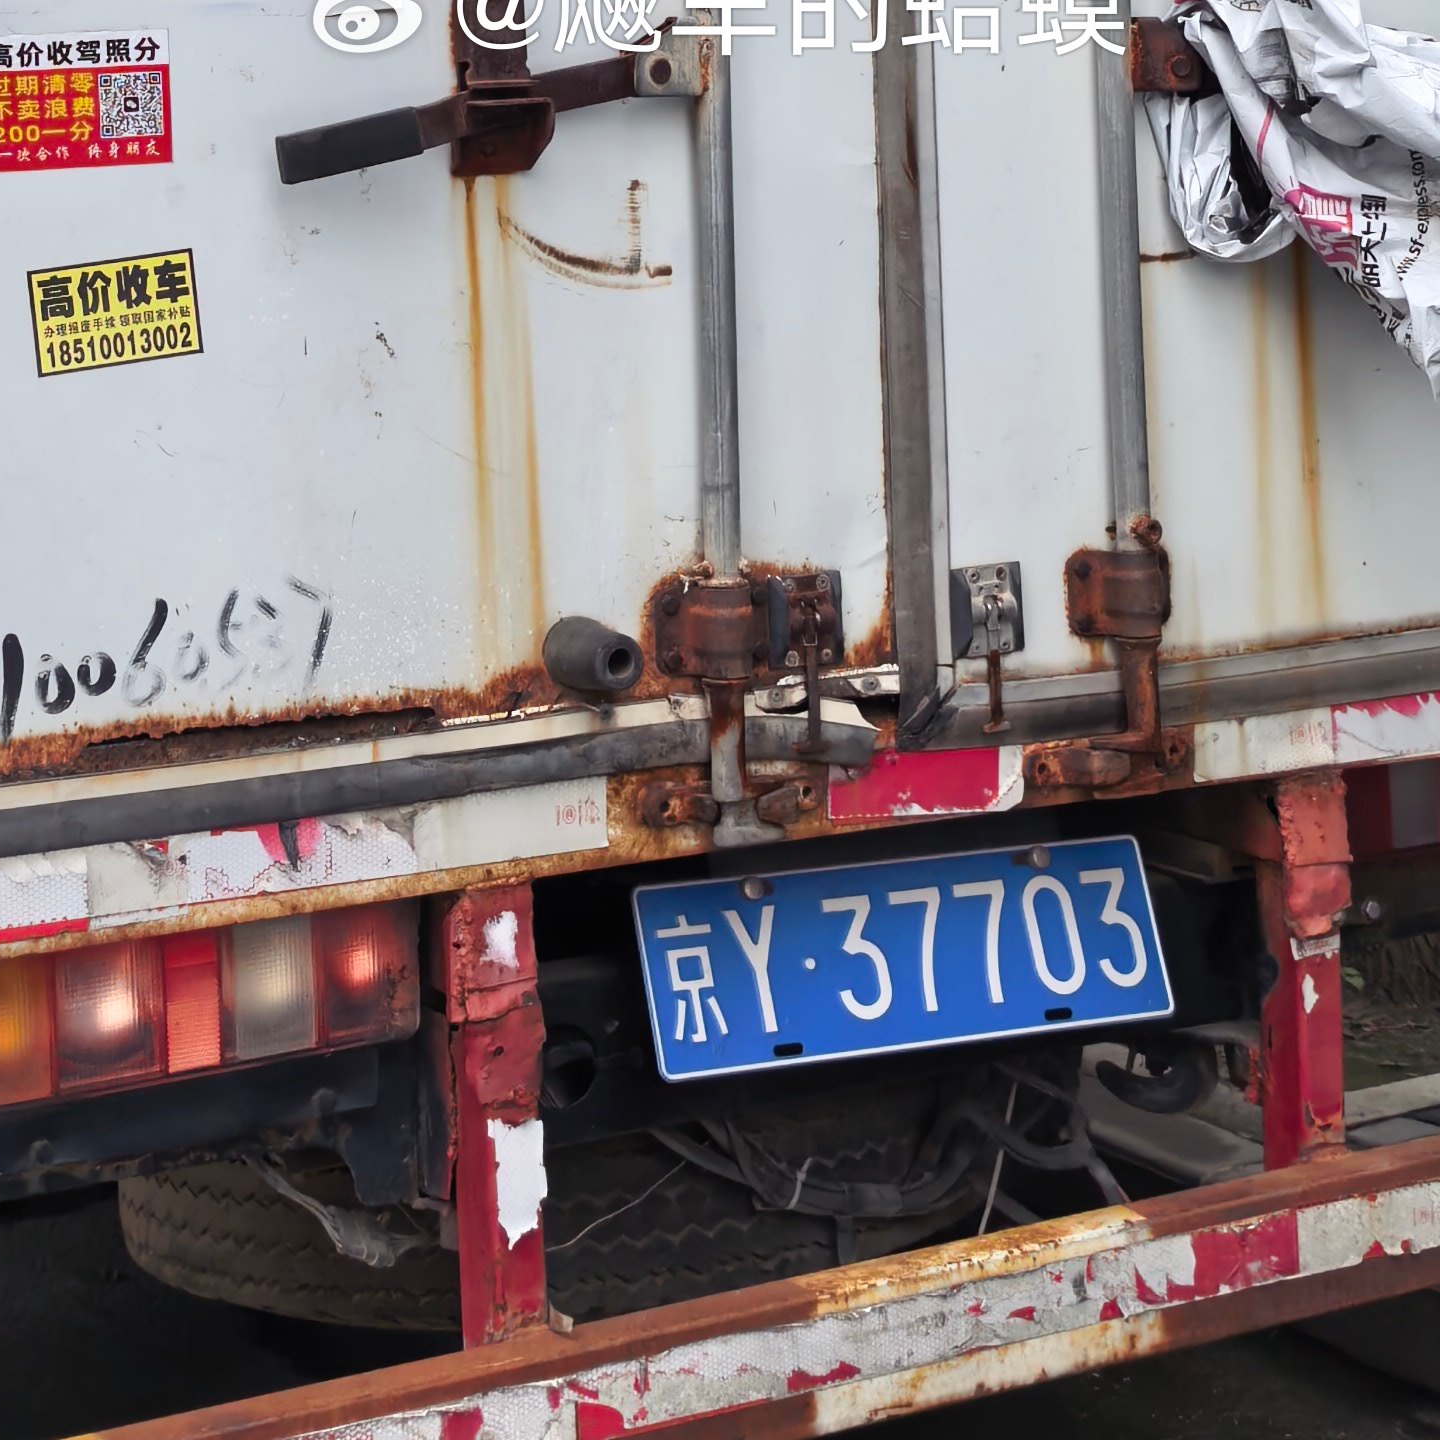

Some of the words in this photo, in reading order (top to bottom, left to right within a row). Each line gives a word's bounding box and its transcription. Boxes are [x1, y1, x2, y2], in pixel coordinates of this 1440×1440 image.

[36, 259, 191, 322] 高价收车
[46, 322, 193, 369] 18510013002
[656, 866, 1148, 1043] 京Y·37703
